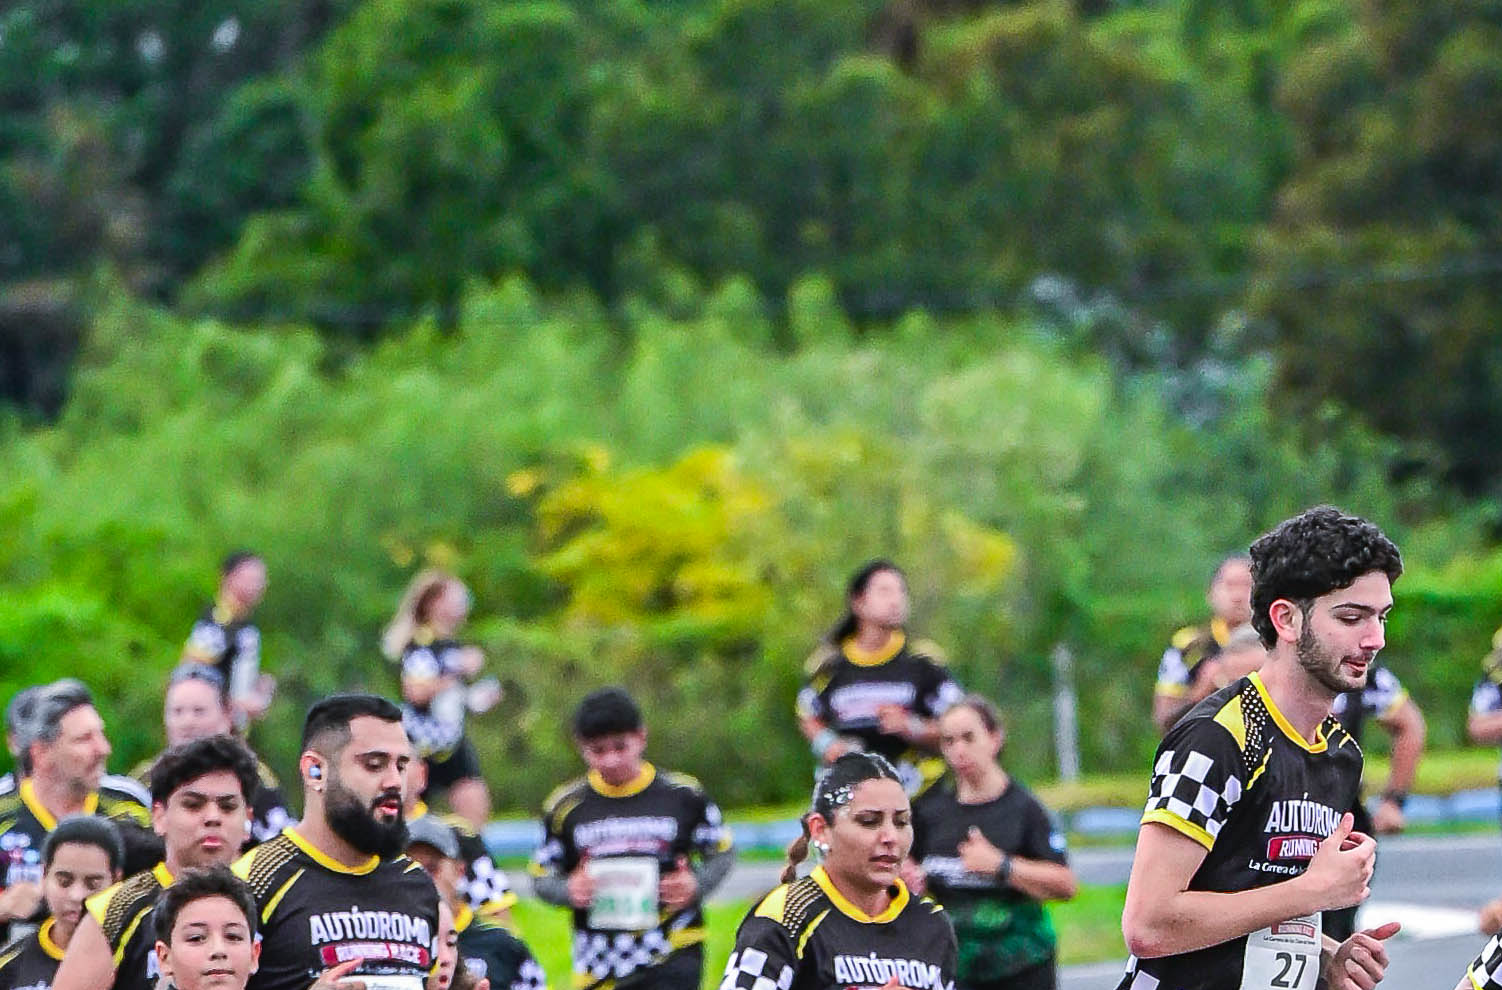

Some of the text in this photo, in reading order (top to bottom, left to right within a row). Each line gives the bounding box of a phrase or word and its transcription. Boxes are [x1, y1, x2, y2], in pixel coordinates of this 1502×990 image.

[1264, 792, 1342, 836] AUTÓDROM
[1249, 859, 1260, 870] La
[1270, 952, 1307, 988] 27
